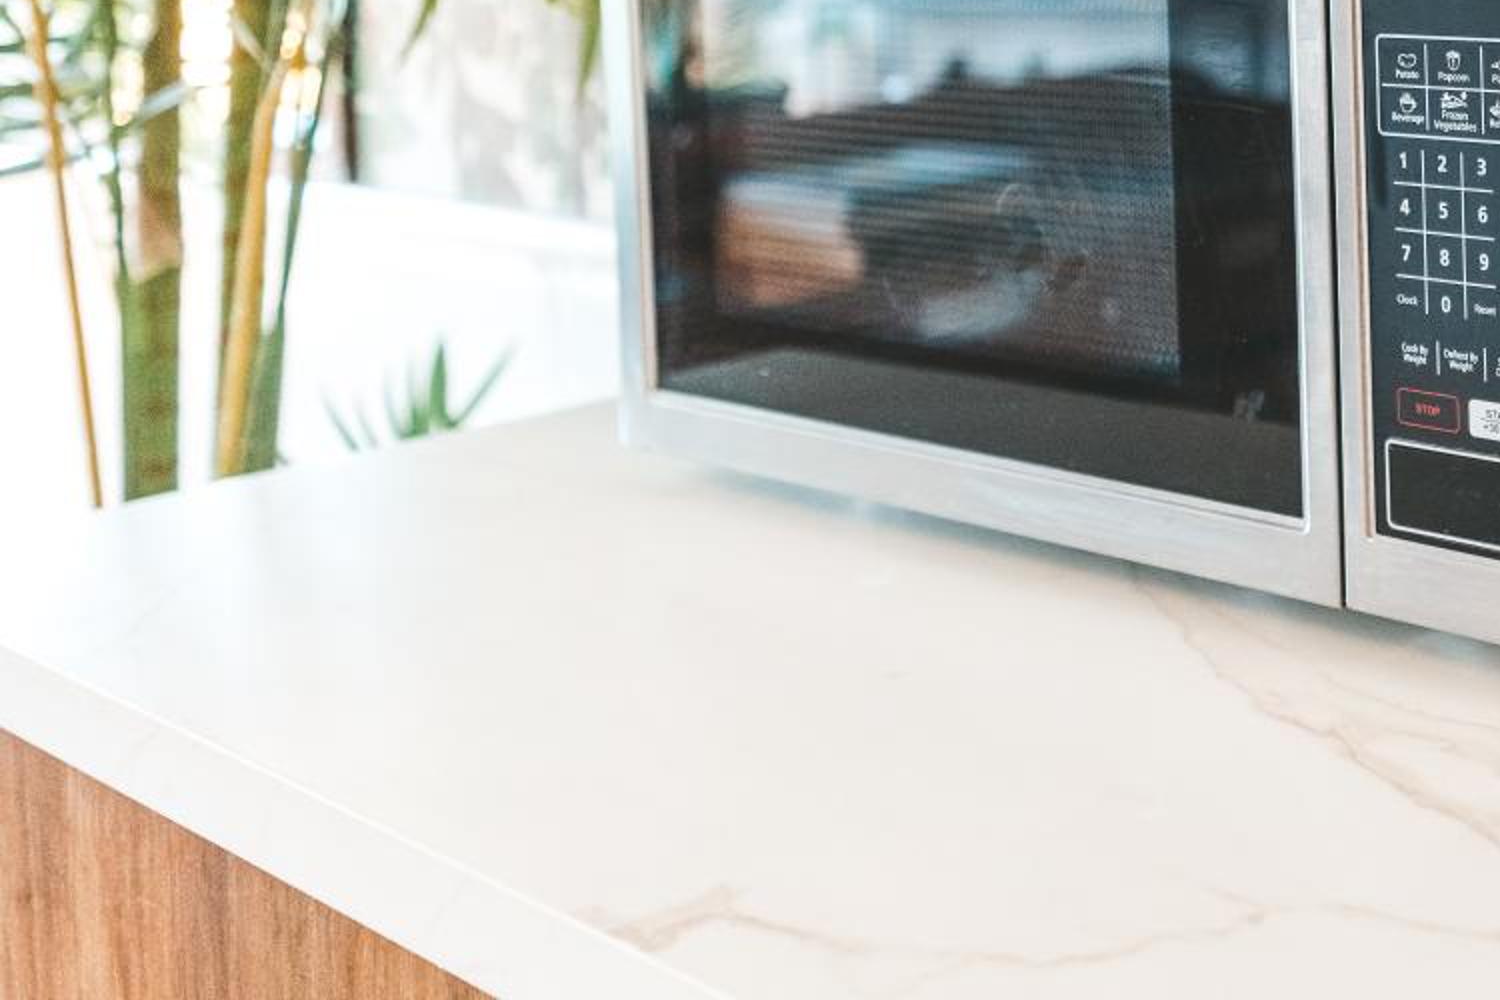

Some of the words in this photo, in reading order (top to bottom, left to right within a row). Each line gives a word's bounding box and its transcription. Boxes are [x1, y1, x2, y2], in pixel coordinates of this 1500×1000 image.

[1438, 71, 1470, 83] Popcorn
[1391, 111, 1425, 125] Beverage
[1441, 110, 1469, 121] Frozen
[1434, 120, 1477, 132] Vegetables
[1400, 152, 1407, 169] 1
[1437, 155, 1448, 173] 2
[1477, 158, 1487, 176] 3
[1400, 199, 1411, 216] 4
[1438, 202, 1449, 219] 5
[1477, 206, 1488, 223] 6
[1401, 245, 1411, 262] 7
[1439, 249, 1450, 266] 8
[1479, 253, 1489, 271] 9
[1396, 294, 1418, 306] Clock
[1441, 296, 1451, 313] 0
[1403, 353, 1427, 367] Weight
[1449, 360, 1473, 373] Weight
[1415, 402, 1441, 417] STOP
